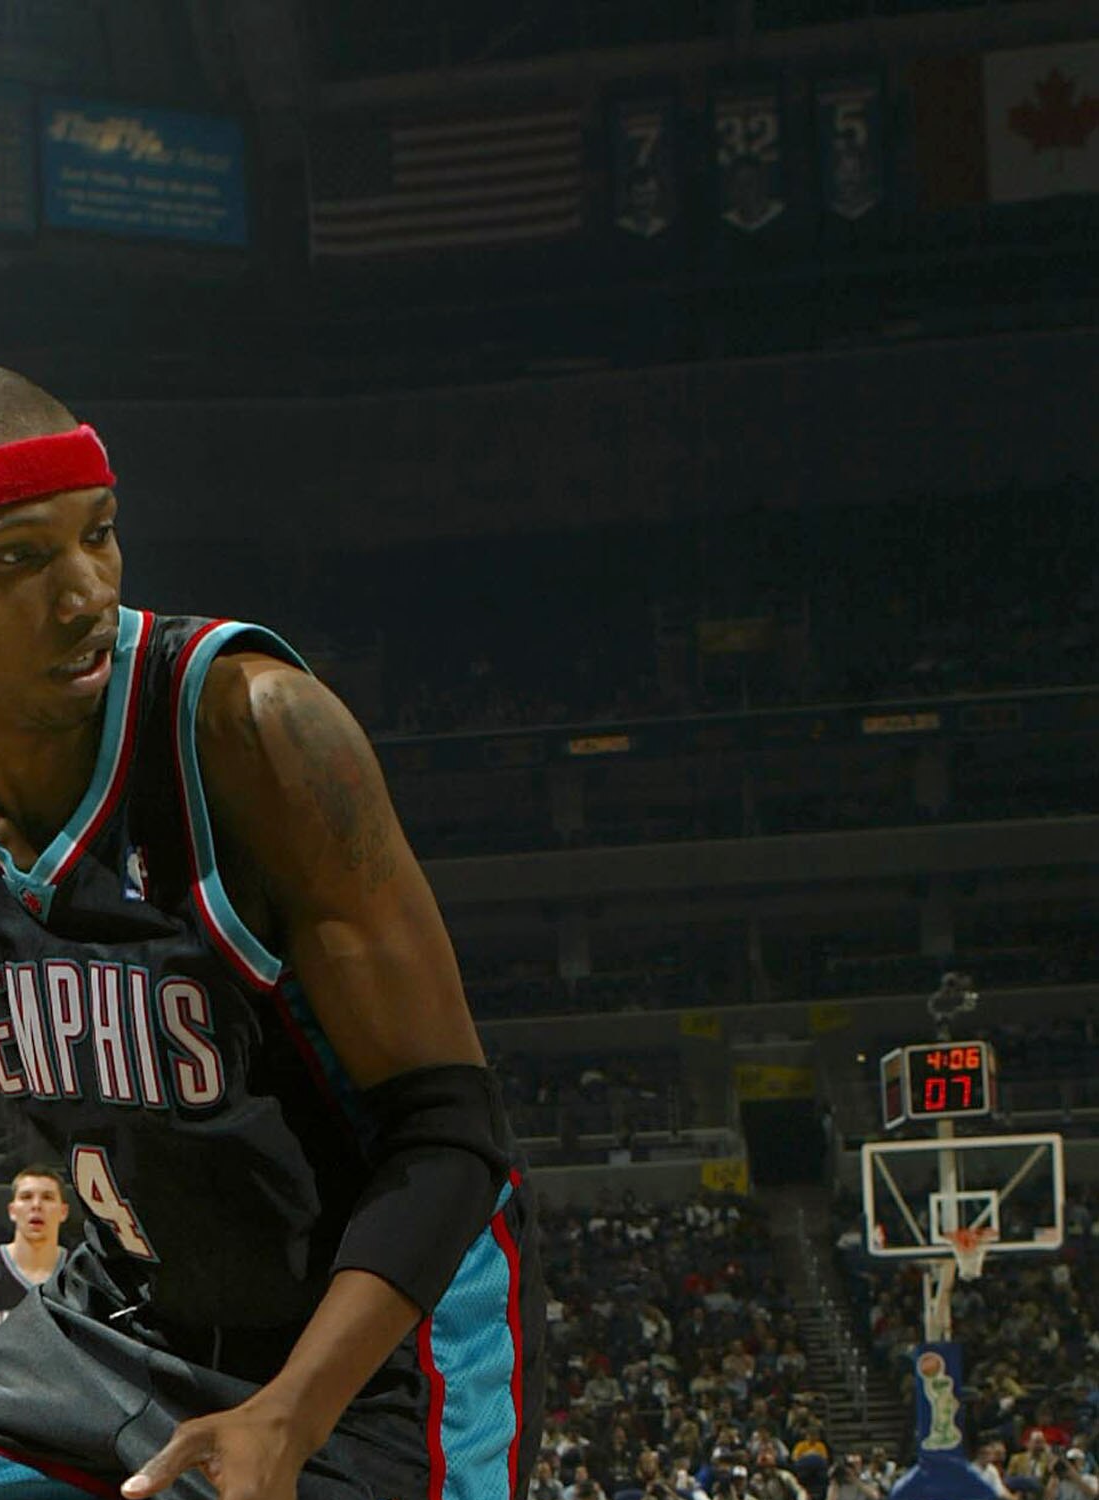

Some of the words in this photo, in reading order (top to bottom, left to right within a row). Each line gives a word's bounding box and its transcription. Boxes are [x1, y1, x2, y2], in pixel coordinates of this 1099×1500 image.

[628, 126, 661, 166] 7
[716, 115, 778, 164] 32
[835, 105, 869, 147] 5
[926, 1046, 980, 1070] 4:06
[924, 1075, 972, 1111] 07
[71, 1143, 160, 1263] 4
